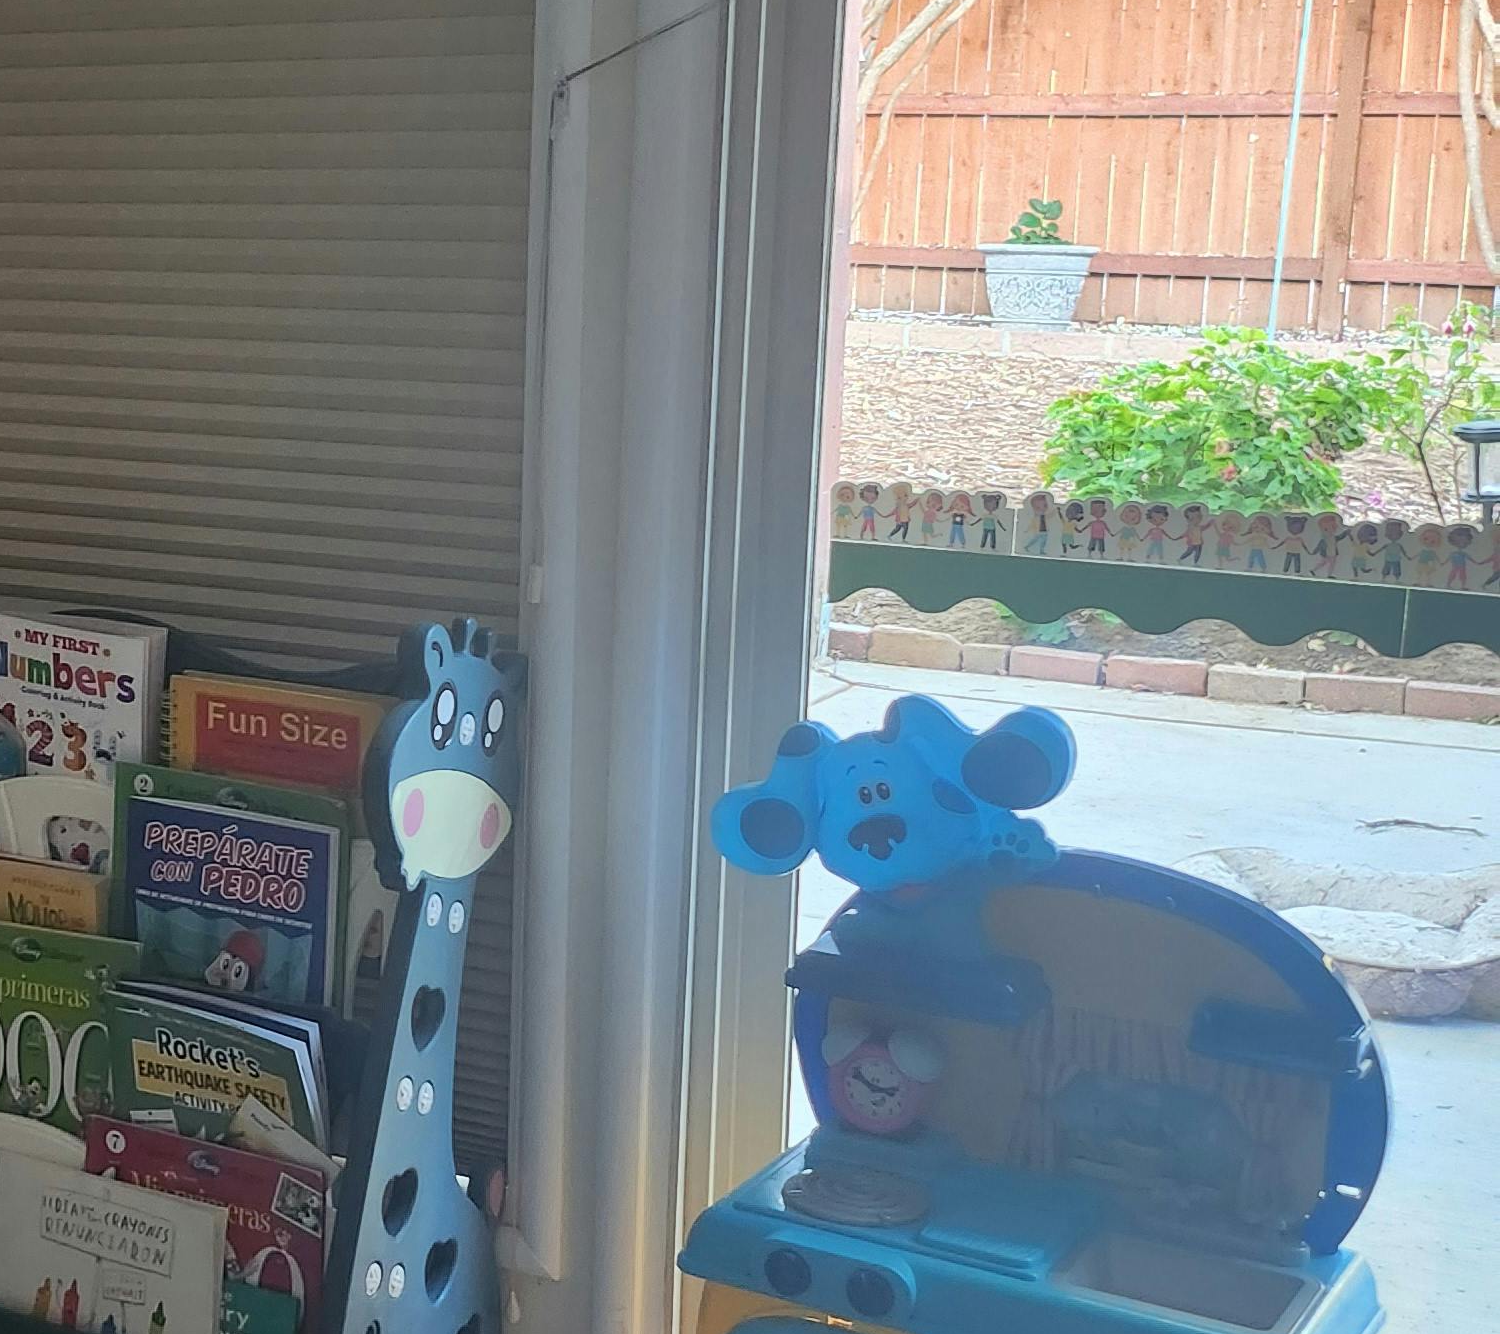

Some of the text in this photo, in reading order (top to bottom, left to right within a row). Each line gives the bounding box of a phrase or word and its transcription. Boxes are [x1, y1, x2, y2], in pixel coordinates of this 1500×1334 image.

[24, 629, 100, 656] MY FIRST
[206, 699, 348, 750] Fun Size
[139, 777, 149, 793] 2
[144, 820, 314, 880] PREPÁRATE
[150, 859, 194, 883] CON
[200, 863, 306, 914] PEDRO
[156, 1027, 261, 1079] Rocket's
[137, 1059, 286, 1111] EARTHQUAKE SAFETY
[174, 1091, 226, 1113] ACTIVITY
[111, 1133, 120, 1150] 7
[44, 1216, 166, 1266] RENUNCIARON
[104, 1211, 170, 1245] CRAYONES
